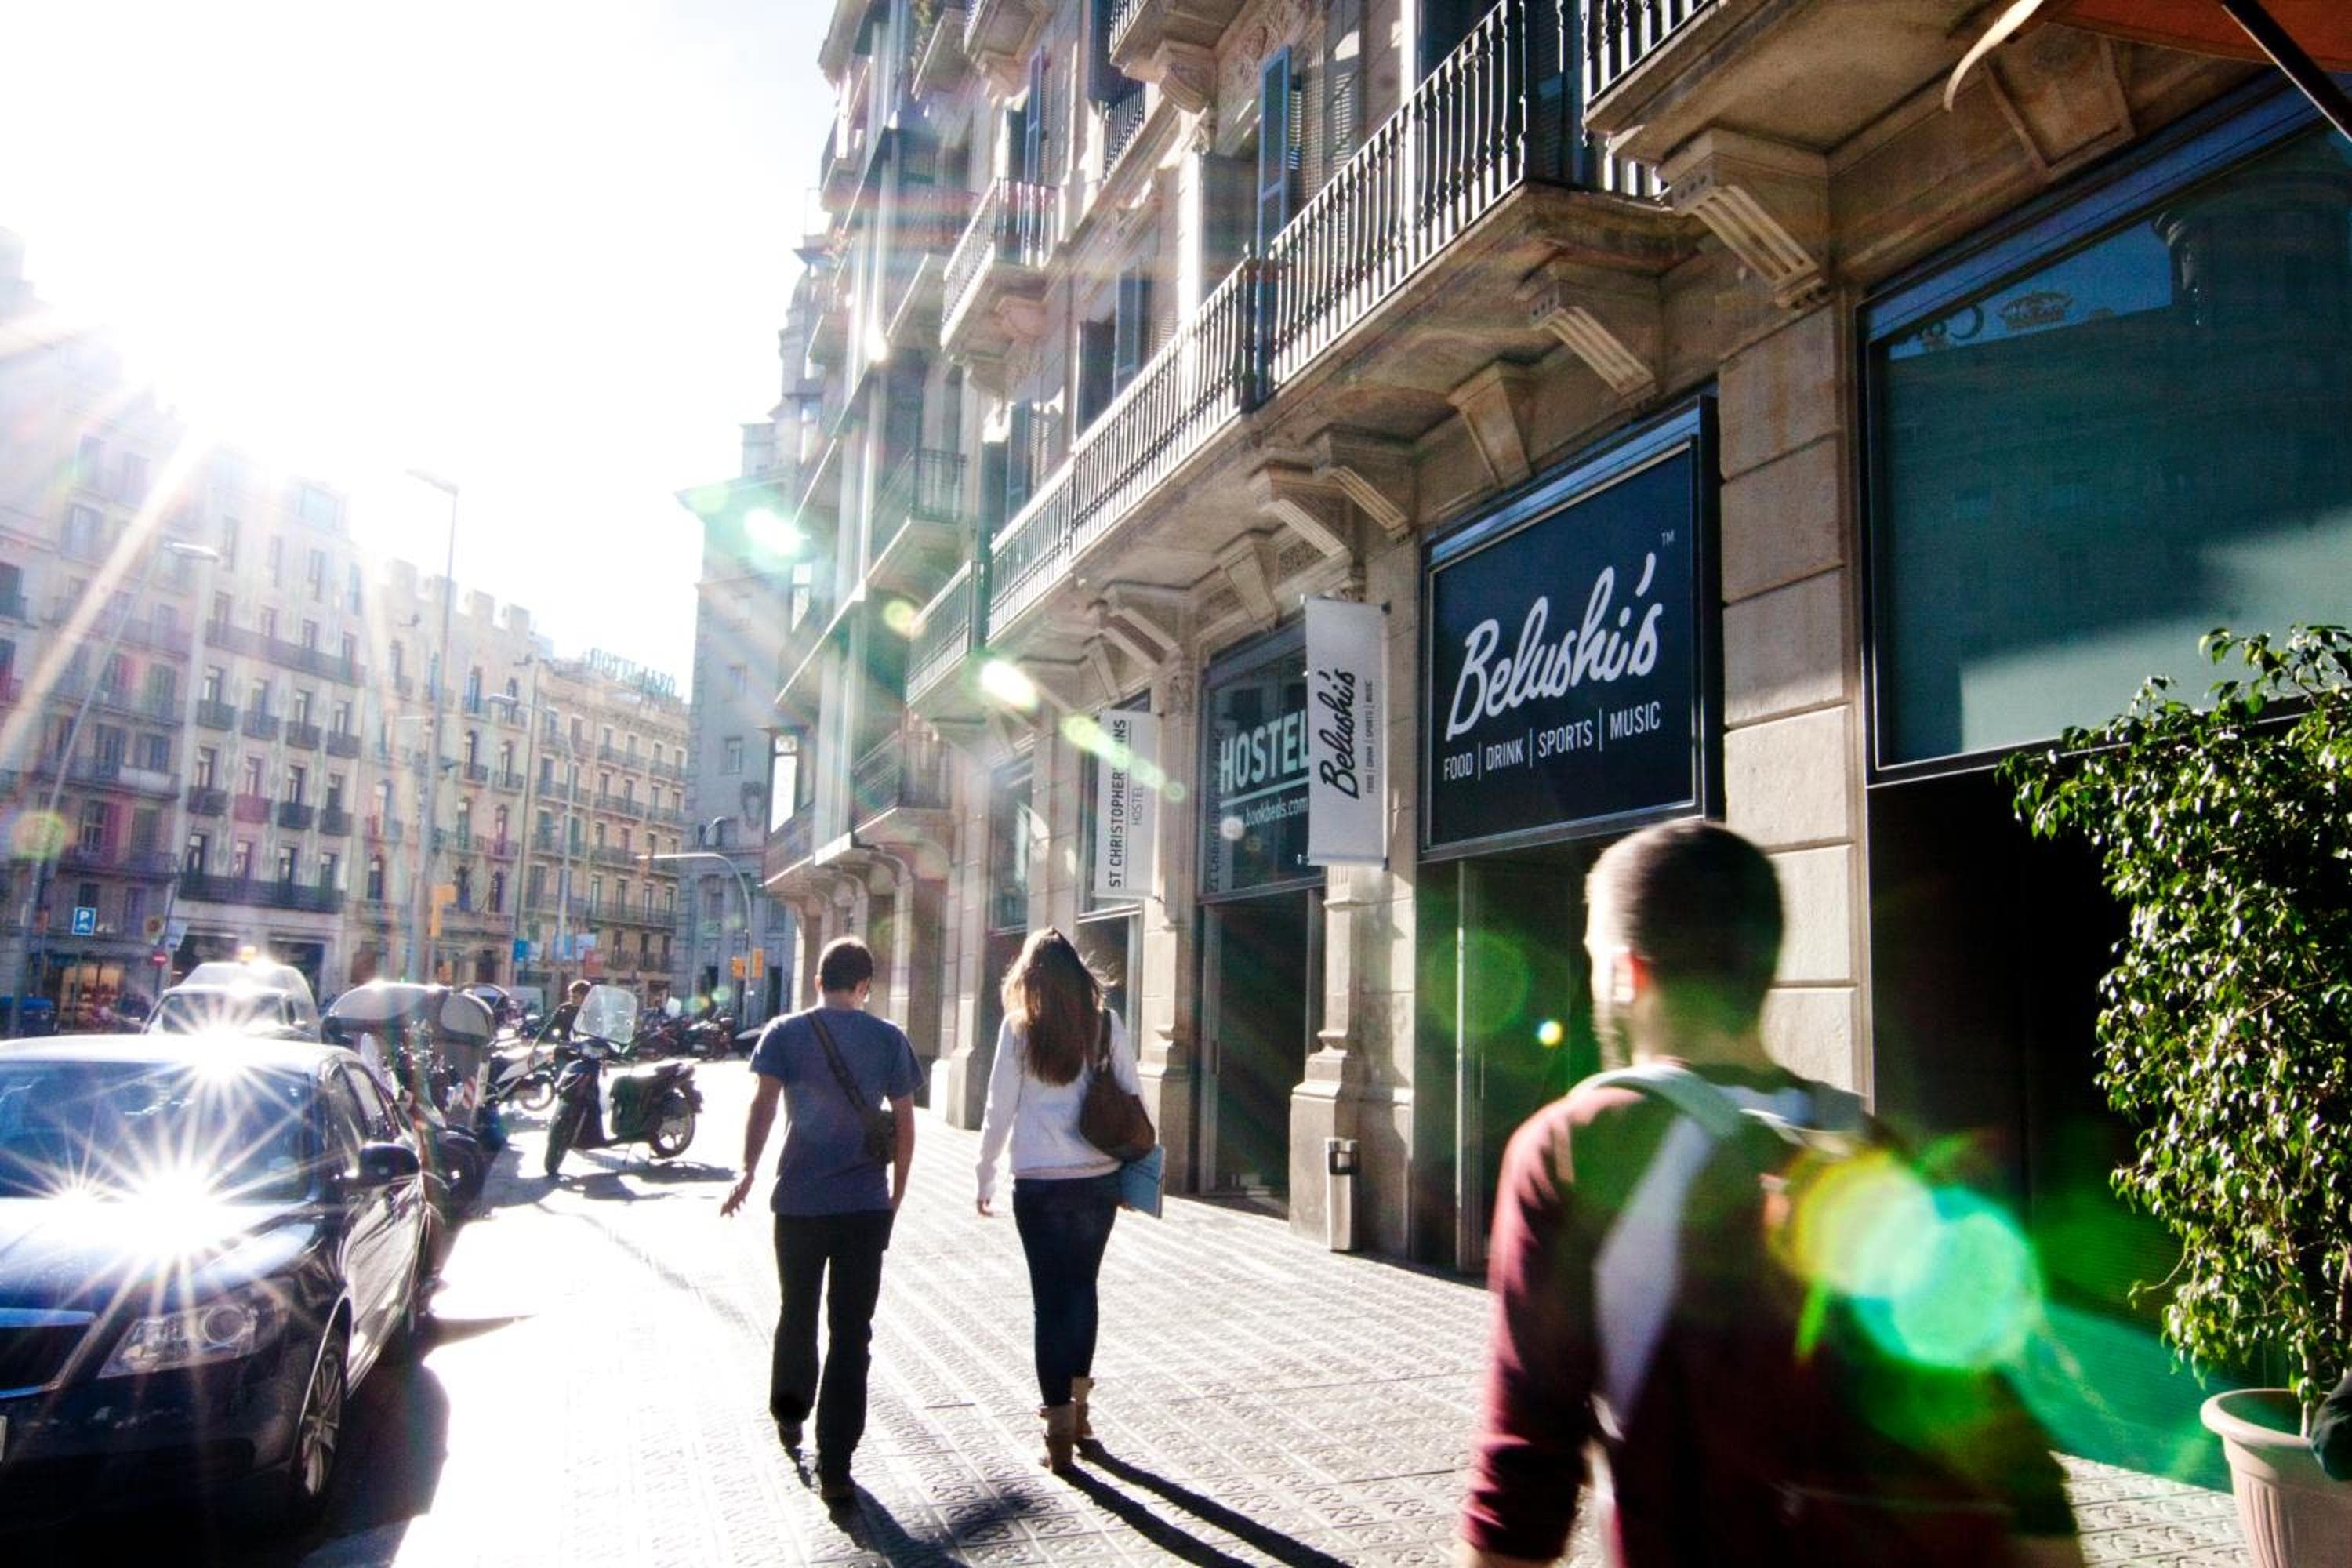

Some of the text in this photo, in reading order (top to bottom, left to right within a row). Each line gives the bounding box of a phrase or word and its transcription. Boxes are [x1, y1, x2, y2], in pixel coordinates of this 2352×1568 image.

[1445, 551, 1663, 742] Belushi's
[1219, 708, 1310, 795] HOSTEL
[1316, 668, 1360, 800] Belushi's
[1443, 701, 1661, 781] FOOD DRINK SPORTS MUSIC
[1109, 759, 1124, 868] CHRISTOPHER'
[1131, 786, 1143, 826] HOSTEL
[80, 911, 90, 921] P
[1109, 871, 1122, 888] ST
